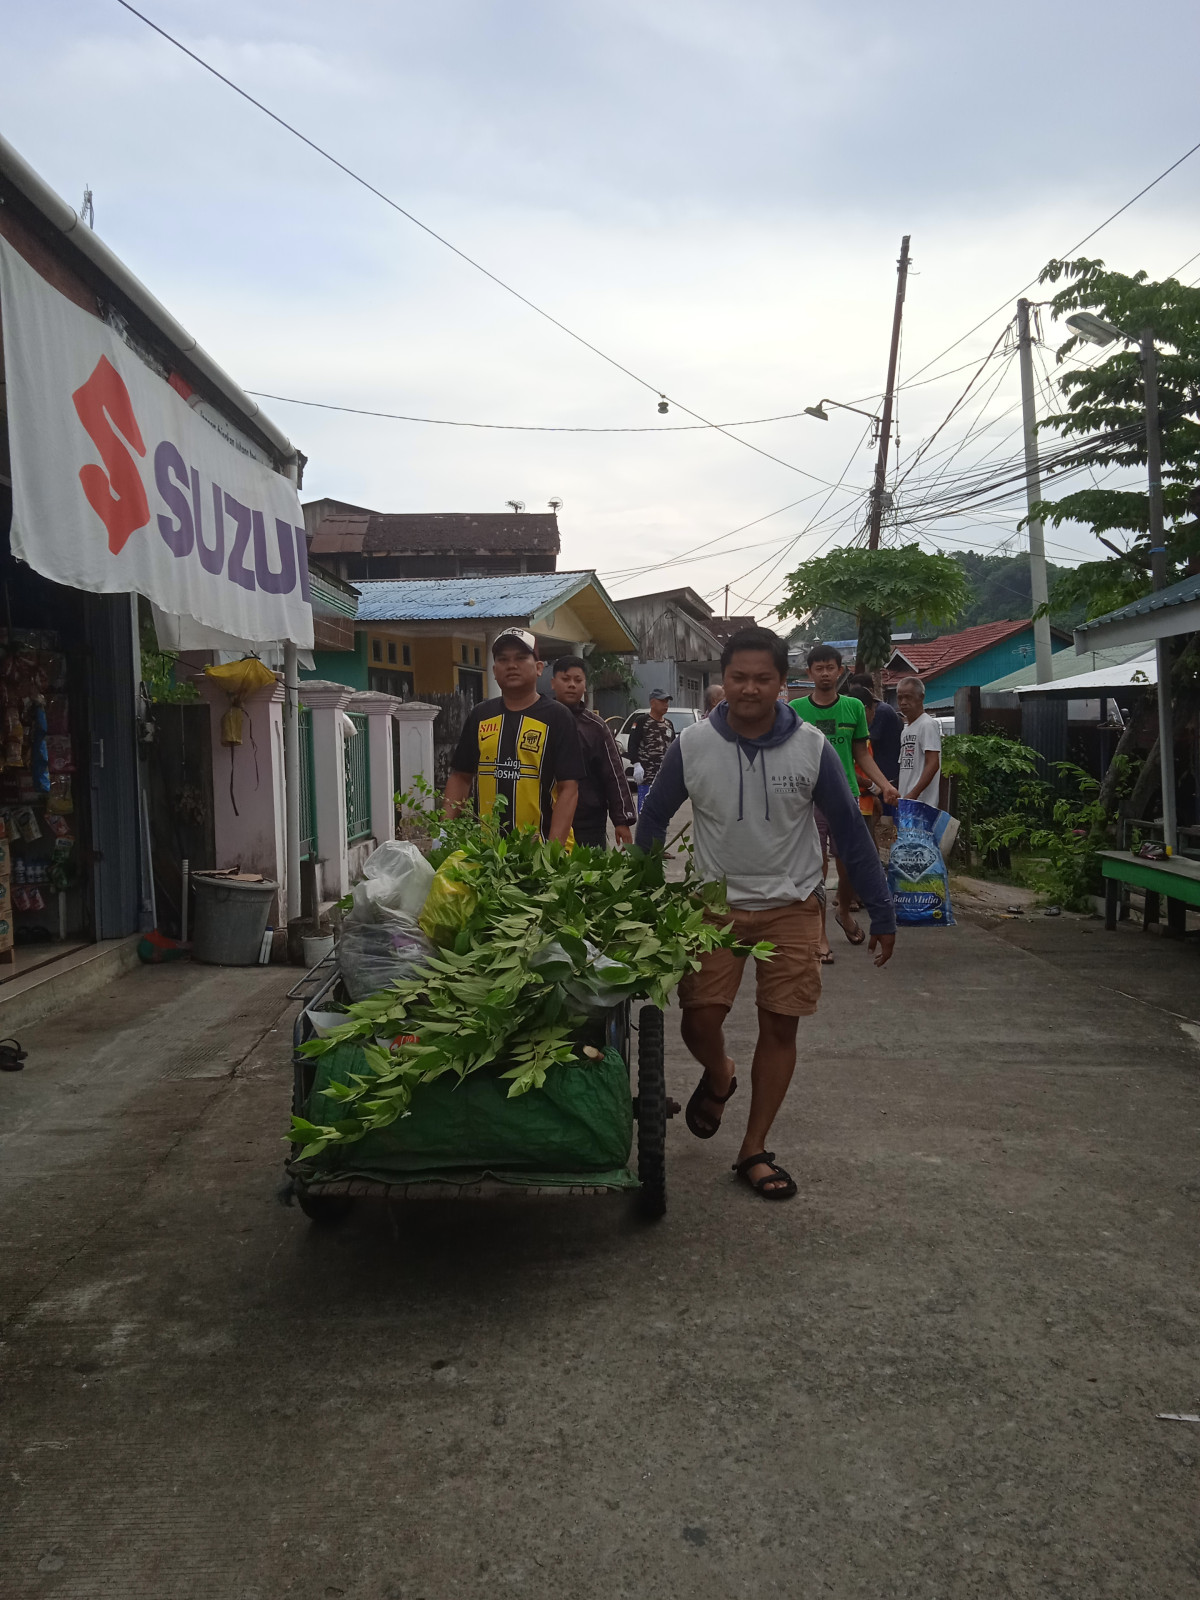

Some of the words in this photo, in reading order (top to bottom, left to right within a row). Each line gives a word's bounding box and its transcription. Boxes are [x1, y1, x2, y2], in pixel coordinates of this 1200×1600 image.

[494, 769, 521, 780] ROSHN
[893, 894, 911, 903] Batu
[914, 894, 939, 904] Mulia
